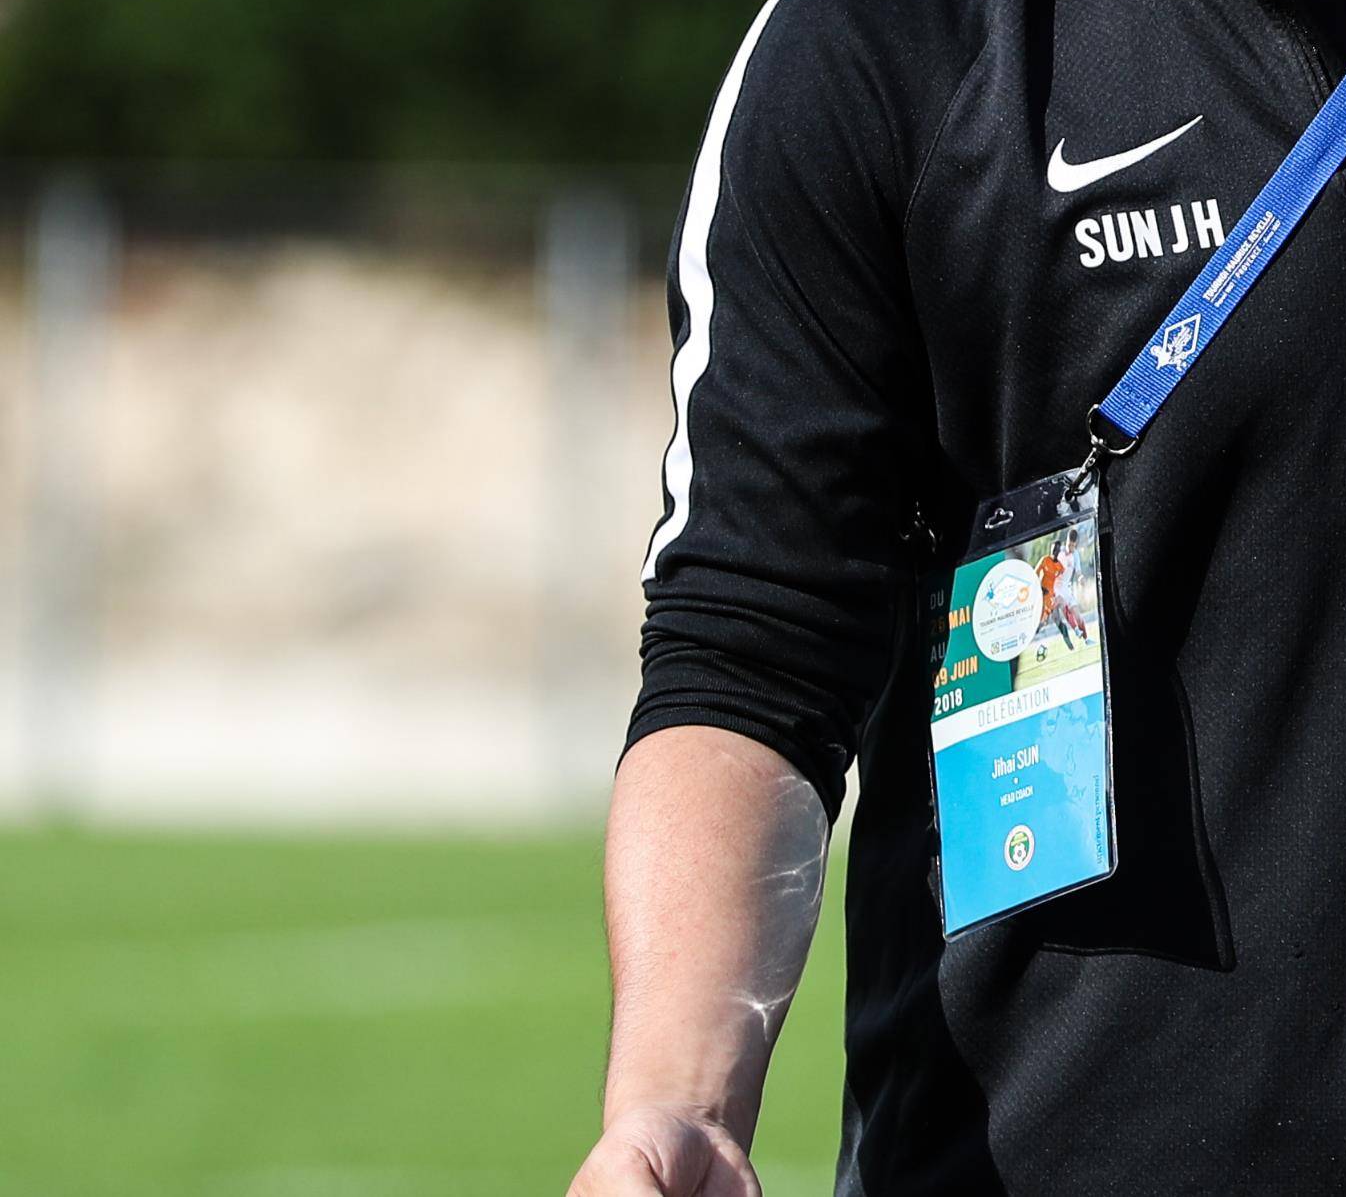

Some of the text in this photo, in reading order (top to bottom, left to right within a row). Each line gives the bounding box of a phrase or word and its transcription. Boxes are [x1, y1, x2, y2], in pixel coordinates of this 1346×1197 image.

[1074, 209, 1164, 268] SUN
[1224, 239, 1251, 273] MAURICE
[1247, 210, 1273, 243] REVELLO
[1234, 245, 1262, 279] PROVENCE
[930, 588, 944, 610] DU
[949, 605, 970, 630] MAI
[930, 642, 946, 662] AU
[951, 656, 978, 681] JUIN
[934, 688, 963, 716] 2018
[992, 745, 1039, 779] Jihai SUN
